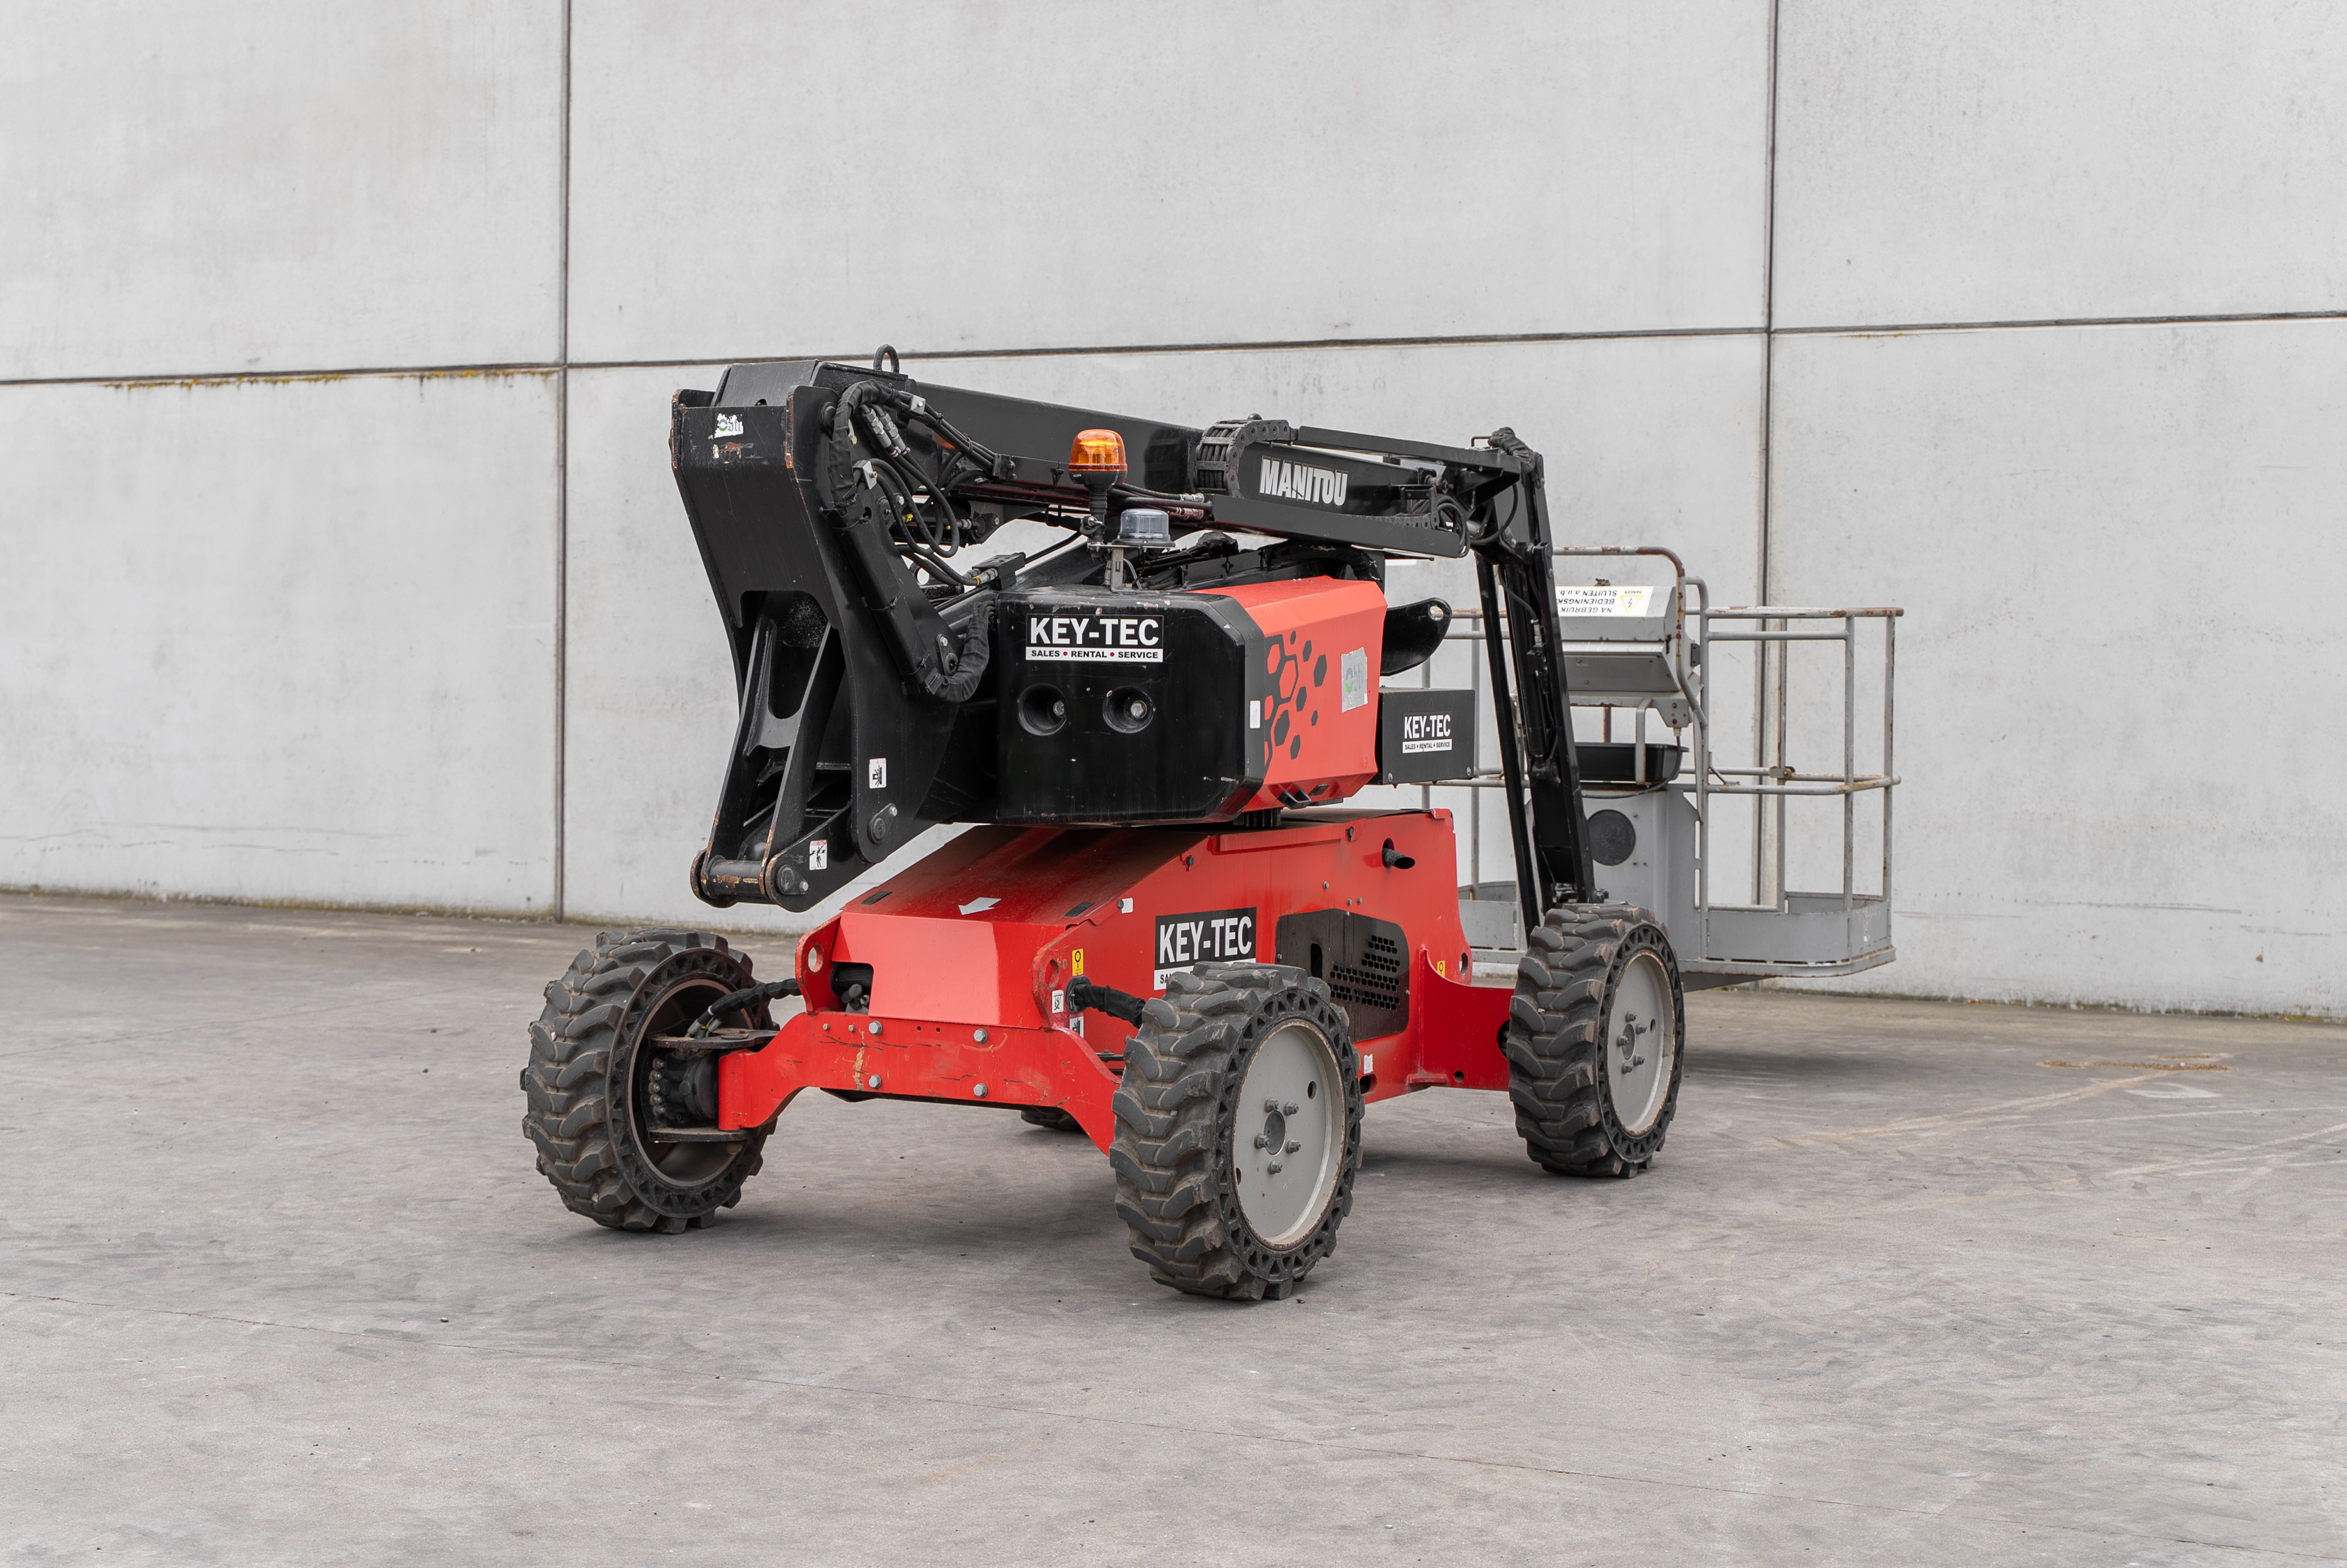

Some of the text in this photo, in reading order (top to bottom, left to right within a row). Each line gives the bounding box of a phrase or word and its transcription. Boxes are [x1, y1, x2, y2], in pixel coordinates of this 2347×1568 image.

[1259, 457, 1348, 506] MANITOU
[1030, 618, 1159, 646] KEY-TEC
[1353, 662, 1364, 692] bti
[1404, 714, 1451, 739] KEY-TEC
[1160, 916, 1252, 964] KEY-TEC
